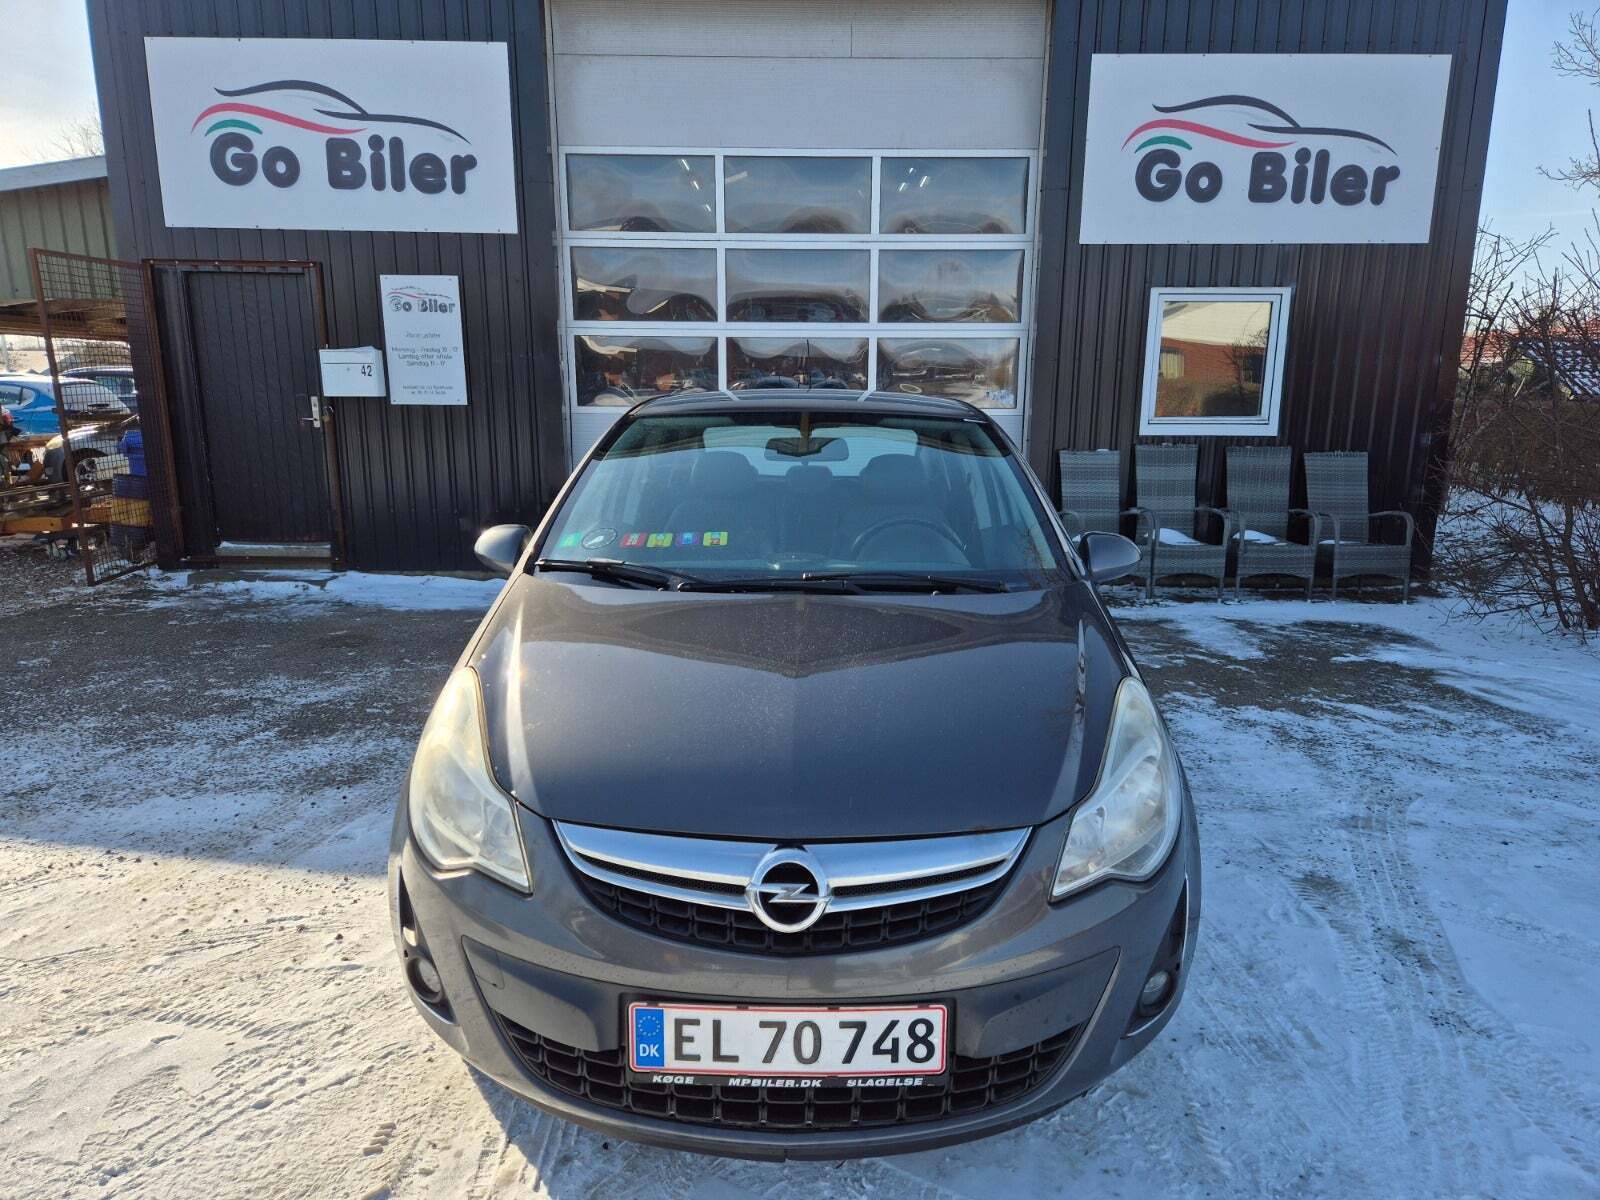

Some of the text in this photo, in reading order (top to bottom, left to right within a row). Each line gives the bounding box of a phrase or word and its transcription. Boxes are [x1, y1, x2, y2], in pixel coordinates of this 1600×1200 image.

[210, 132, 477, 194] Go Biler
[1135, 147, 1400, 206] Go Biler
[418, 298, 455, 313] Biler
[361, 365, 373, 377] 42
[673, 1018, 936, 1065] EL 70 748
[639, 1043, 660, 1058] DK
[652, 1075, 924, 1088] KØGE MPBILER.DK SLAGELSE
